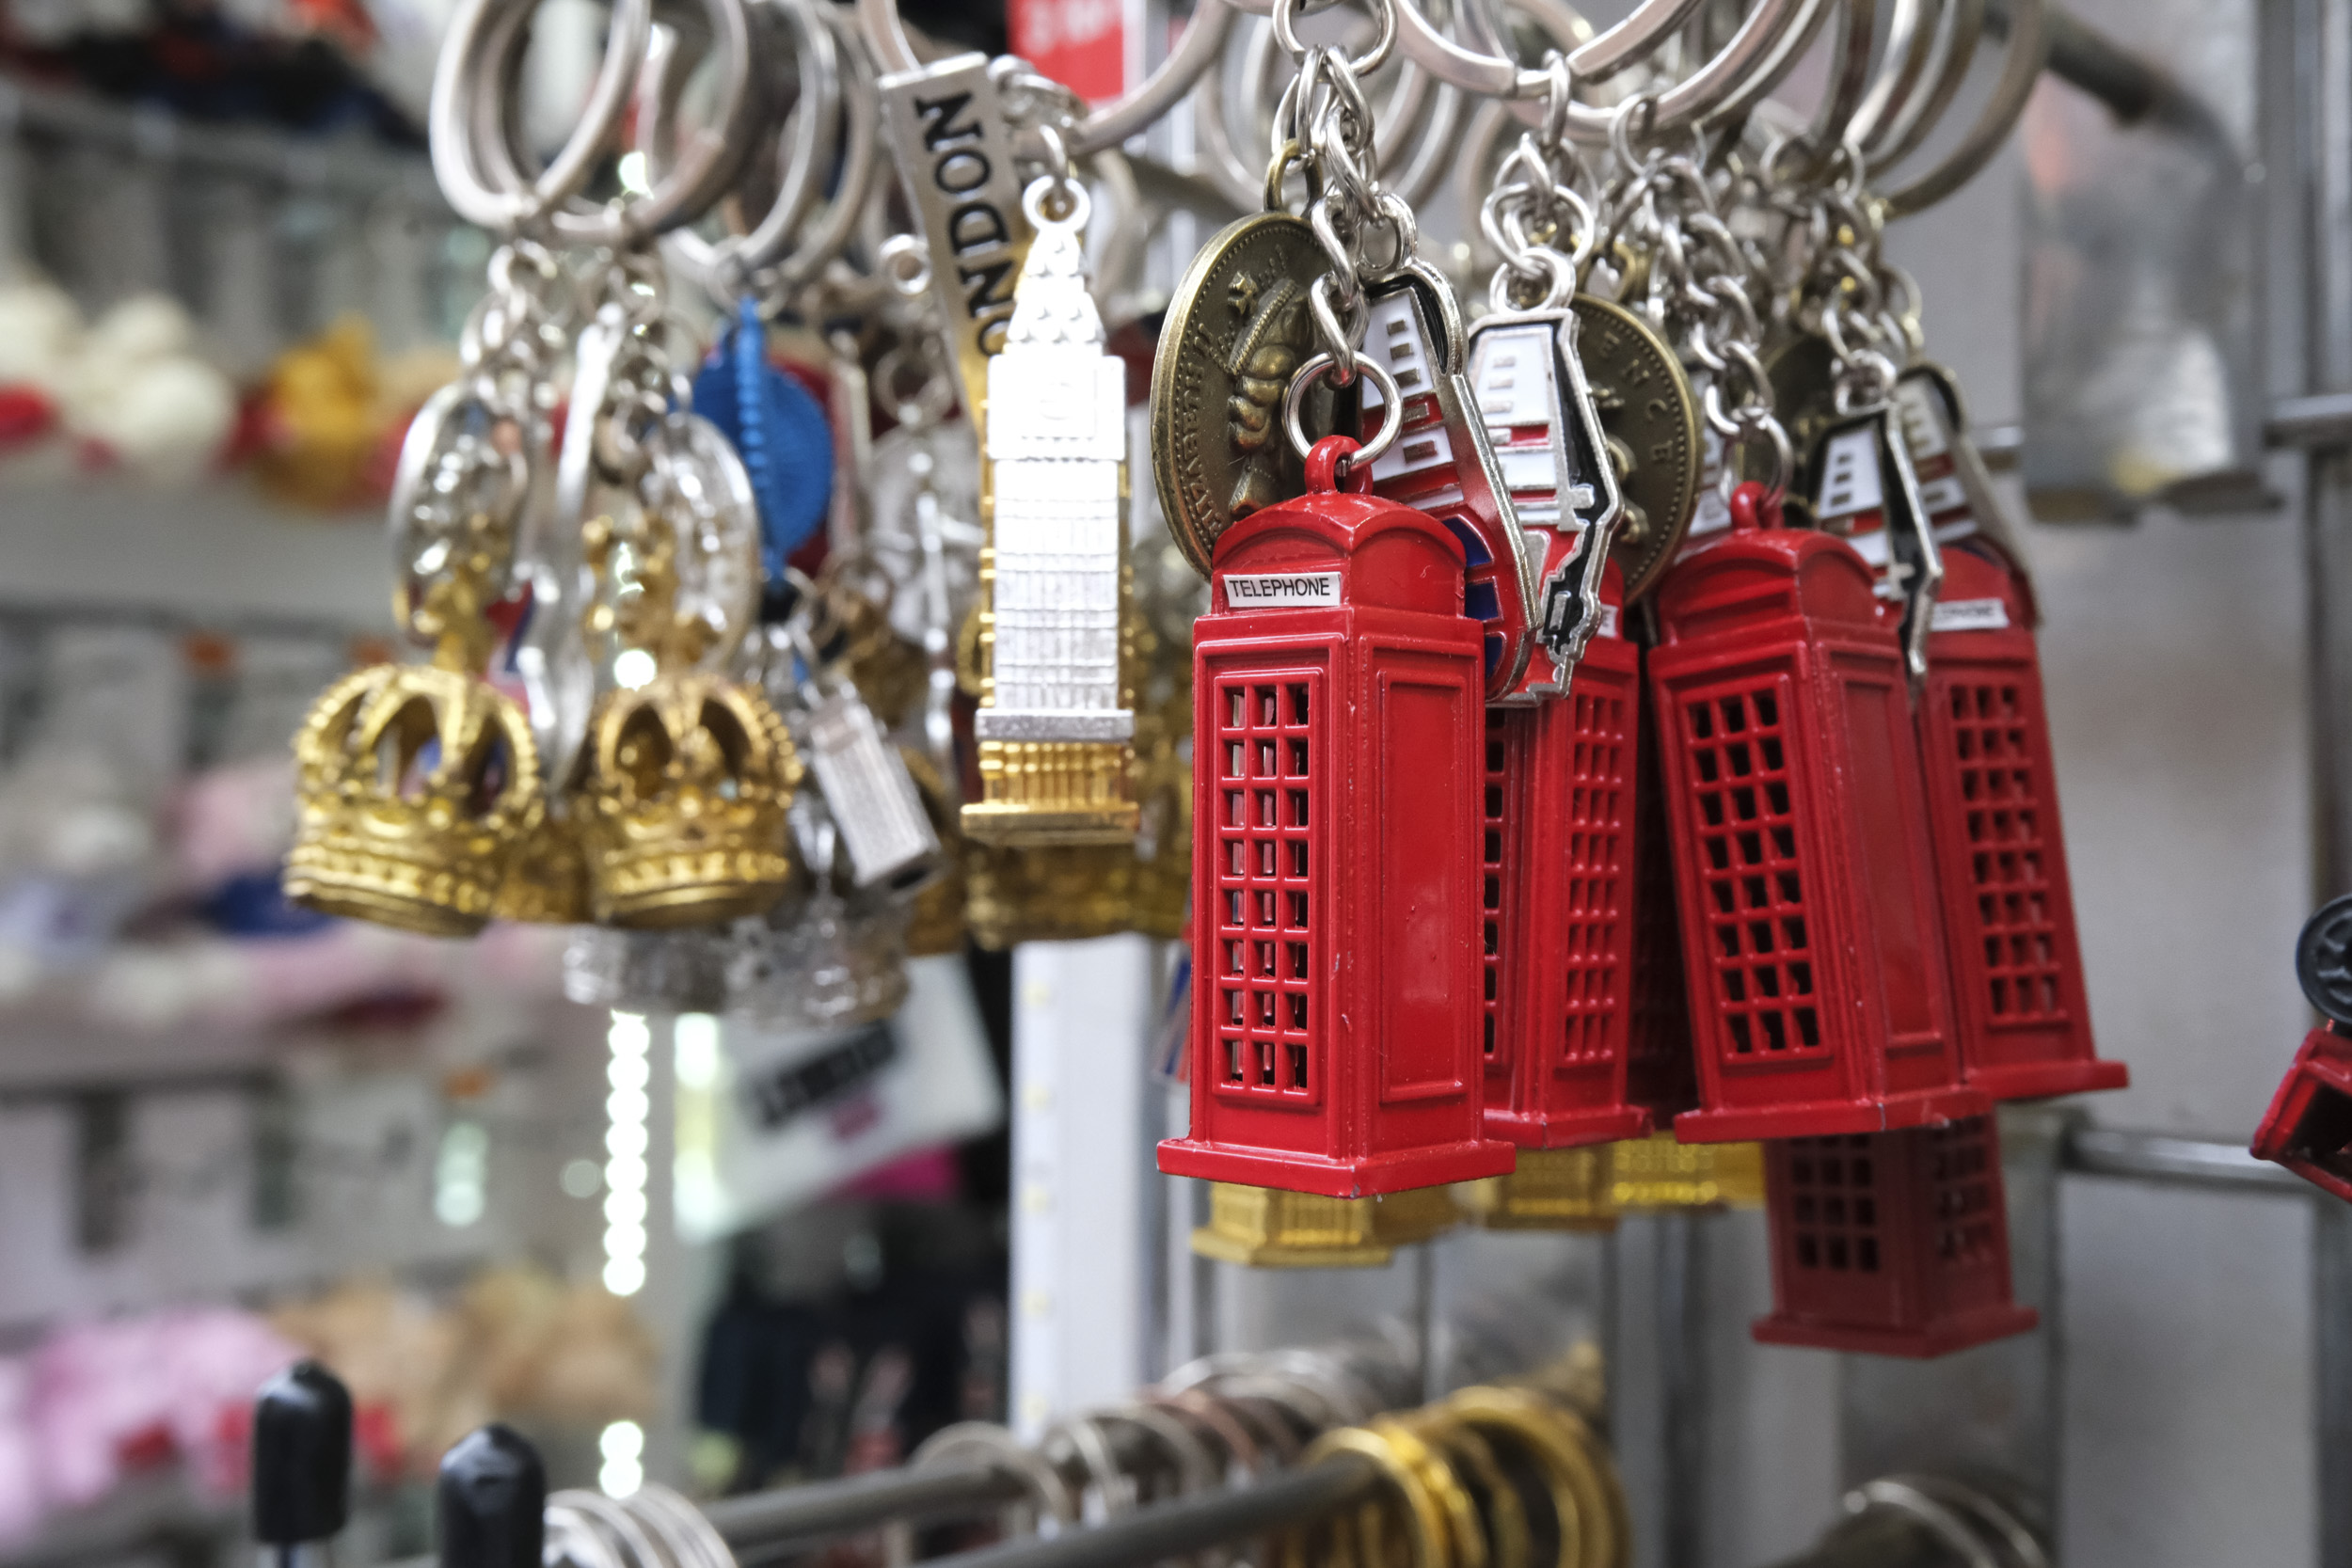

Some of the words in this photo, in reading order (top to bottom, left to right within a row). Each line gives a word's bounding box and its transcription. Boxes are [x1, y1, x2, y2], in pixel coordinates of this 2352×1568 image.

[914, 91, 1016, 357] ONDON
[1183, 362, 1224, 538] ELIZABETH
[1581, 324, 1674, 462] ENCE
[1229, 578, 1330, 597] TELEPHONE
